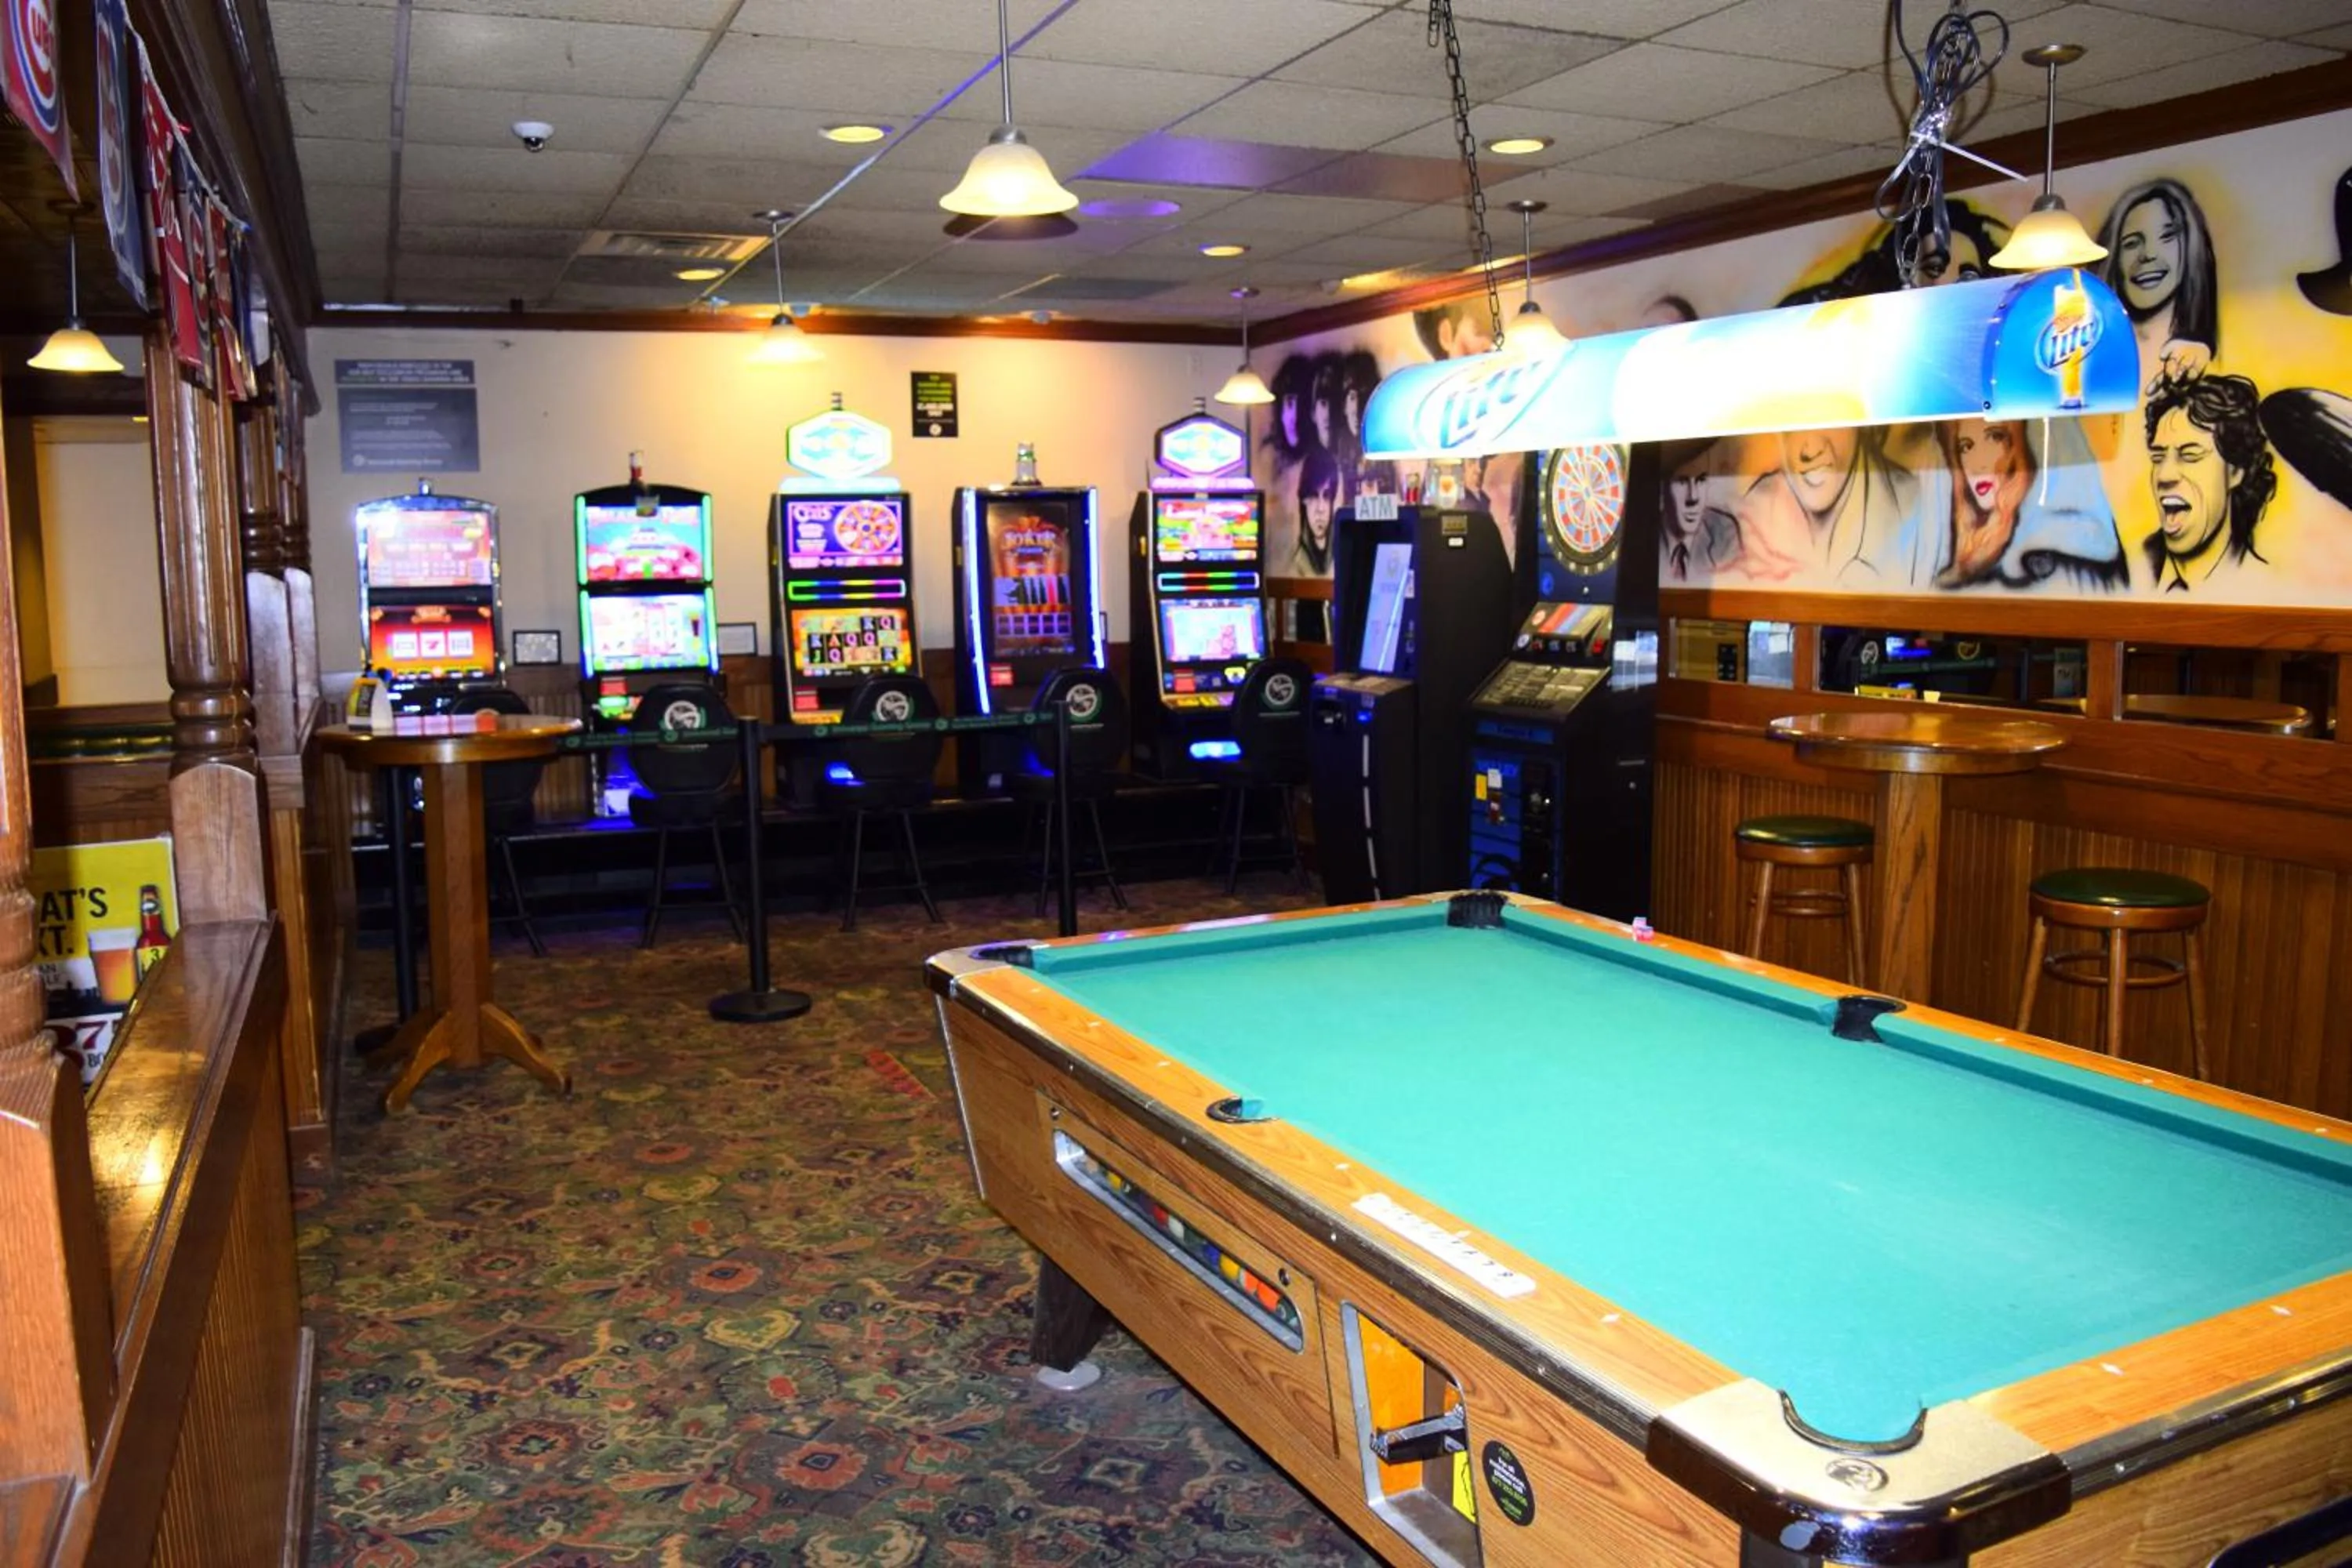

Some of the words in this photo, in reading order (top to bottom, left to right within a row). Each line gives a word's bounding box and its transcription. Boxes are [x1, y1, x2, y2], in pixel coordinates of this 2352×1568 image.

[2049, 321, 2095, 368] Lite
[1359, 495, 1393, 518] ATM
[1003, 530, 1057, 547] JOKER
